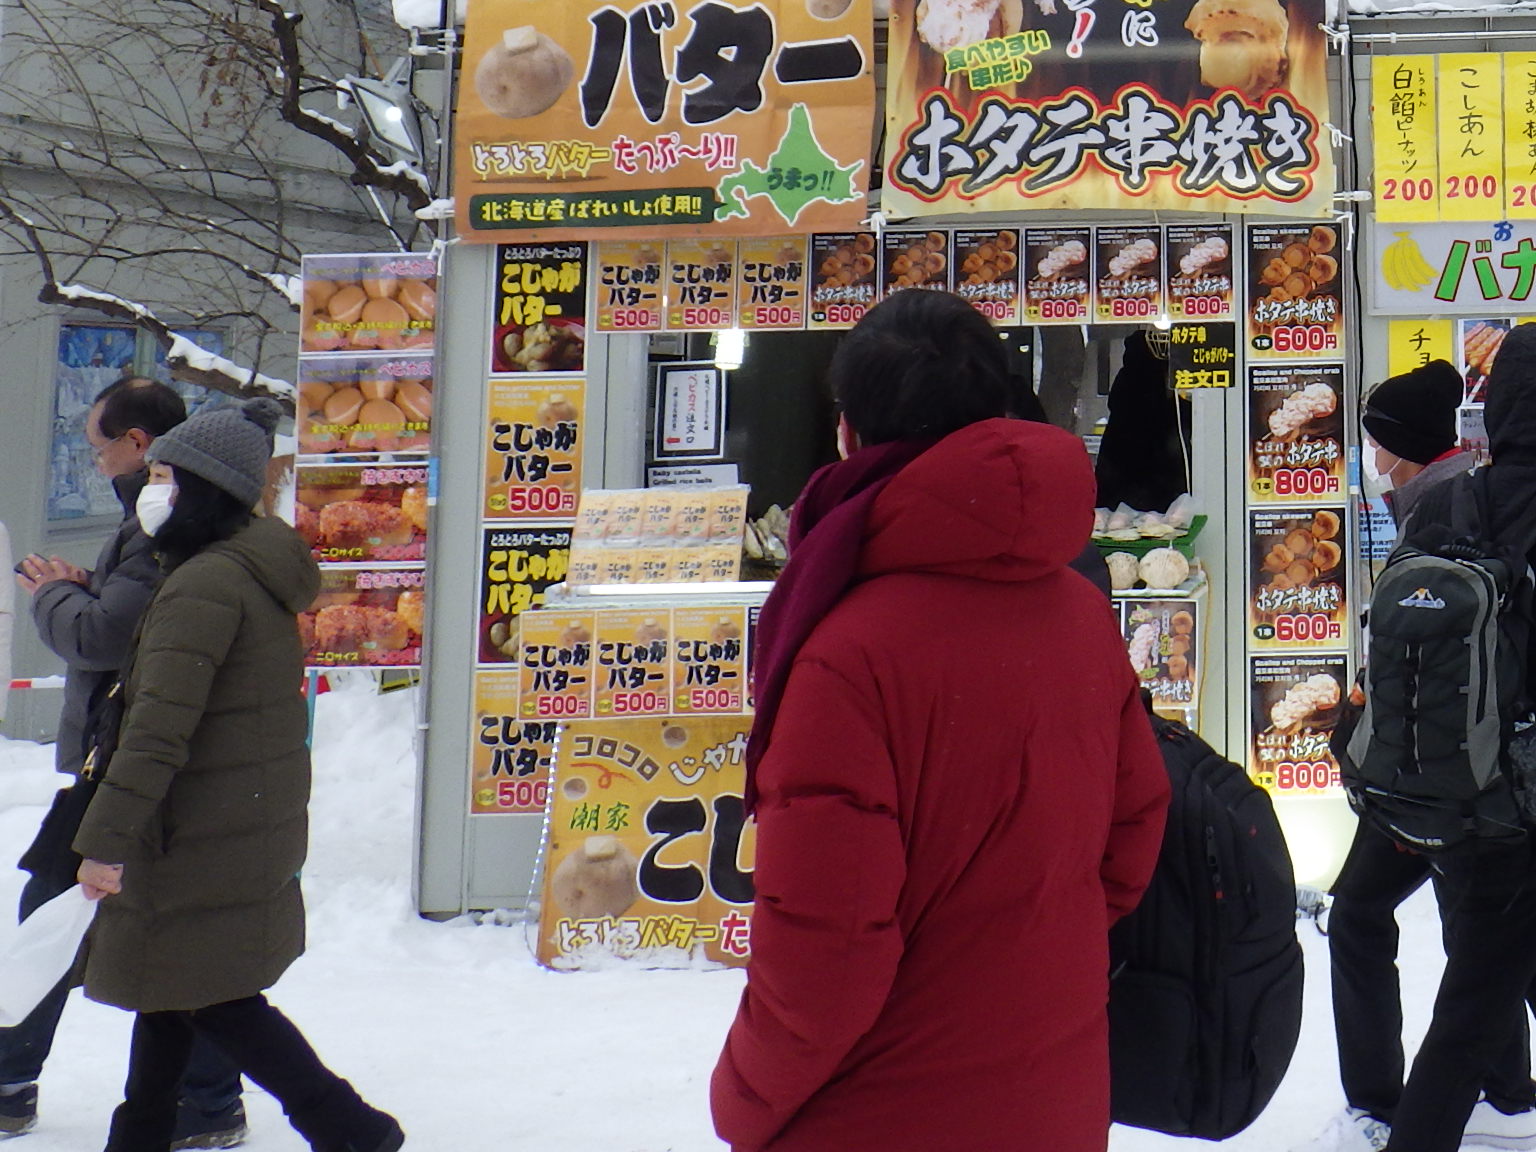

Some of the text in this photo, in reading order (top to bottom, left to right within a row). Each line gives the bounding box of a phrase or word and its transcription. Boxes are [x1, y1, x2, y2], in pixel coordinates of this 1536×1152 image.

[945, 30, 1052, 73] 食べやすい
[578, 0, 864, 129] バター
[1458, 67, 1485, 158] こしあん
[897, 91, 1312, 200] ホタテ串焼き
[472, 142, 611, 179] とろとろバター
[1382, 177, 1434, 202] 200
[1445, 174, 1498, 199] 200
[502, 262, 582, 294] こじゃが
[609, 287, 657, 306] バター
[681, 285, 729, 305] バター
[751, 284, 799, 303] バター
[501, 295, 562, 326] バター
[1254, 299, 1336, 323] ホタテ串焼き
[1273, 327, 1337, 351] 600円
[1175, 370, 1230, 388] 注文口
[493, 422, 577, 451] こじゃが
[1286, 440, 1338, 465] ホタテ串
[503, 454, 573, 482] バター
[1275, 469, 1339, 495] 800円
[510, 486, 575, 512] 500円
[487, 549, 569, 581] こじゃが
[1256, 586, 1341, 611] ホタテ串焼き
[1275, 614, 1341, 640] 600円
[524, 644, 591, 667] こじゃが
[599, 641, 668, 665] こじゃが
[676, 640, 741, 663] こじゃが
[533, 670, 586, 691] バター
[609, 667, 665, 689] バター
[686, 664, 738, 686] バター
[573, 735, 661, 782] コロコロ
[1289, 734, 1331, 759] ホタテ
[1277, 763, 1342, 789] 800円
[499, 782, 548, 807] 500
[555, 915, 719, 954] とろとろバター
